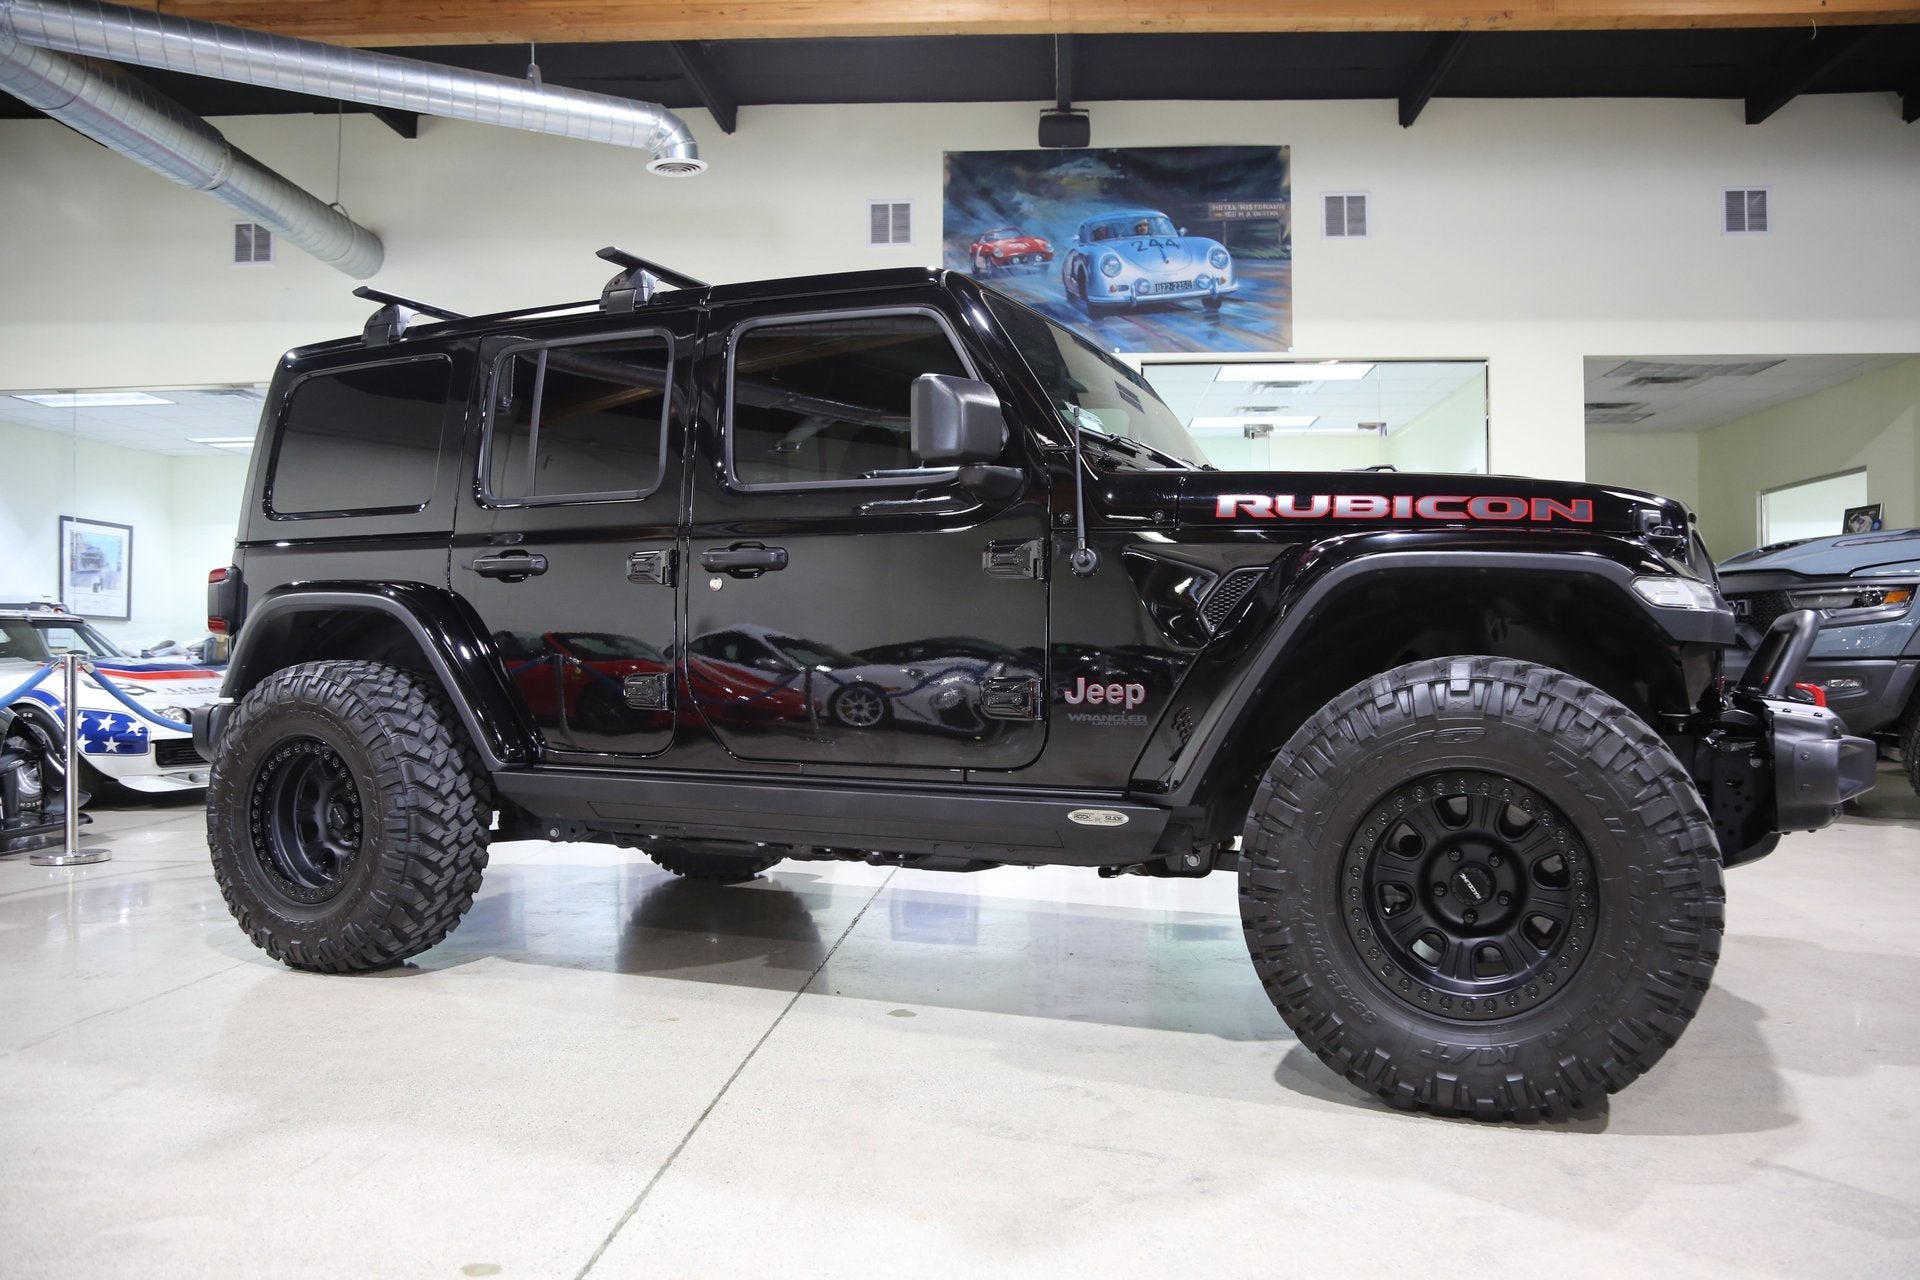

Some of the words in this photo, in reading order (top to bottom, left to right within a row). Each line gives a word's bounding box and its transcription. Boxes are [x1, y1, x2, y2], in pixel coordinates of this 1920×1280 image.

[1212, 203, 1238, 211] HOTEL
[1131, 238, 1180, 252] 244
[1214, 494, 1594, 523] RUBICON
[1064, 677, 1146, 710] Jeep
[1068, 713, 1148, 722] WRANGLER
[1459, 872, 1483, 900] RACELINE
